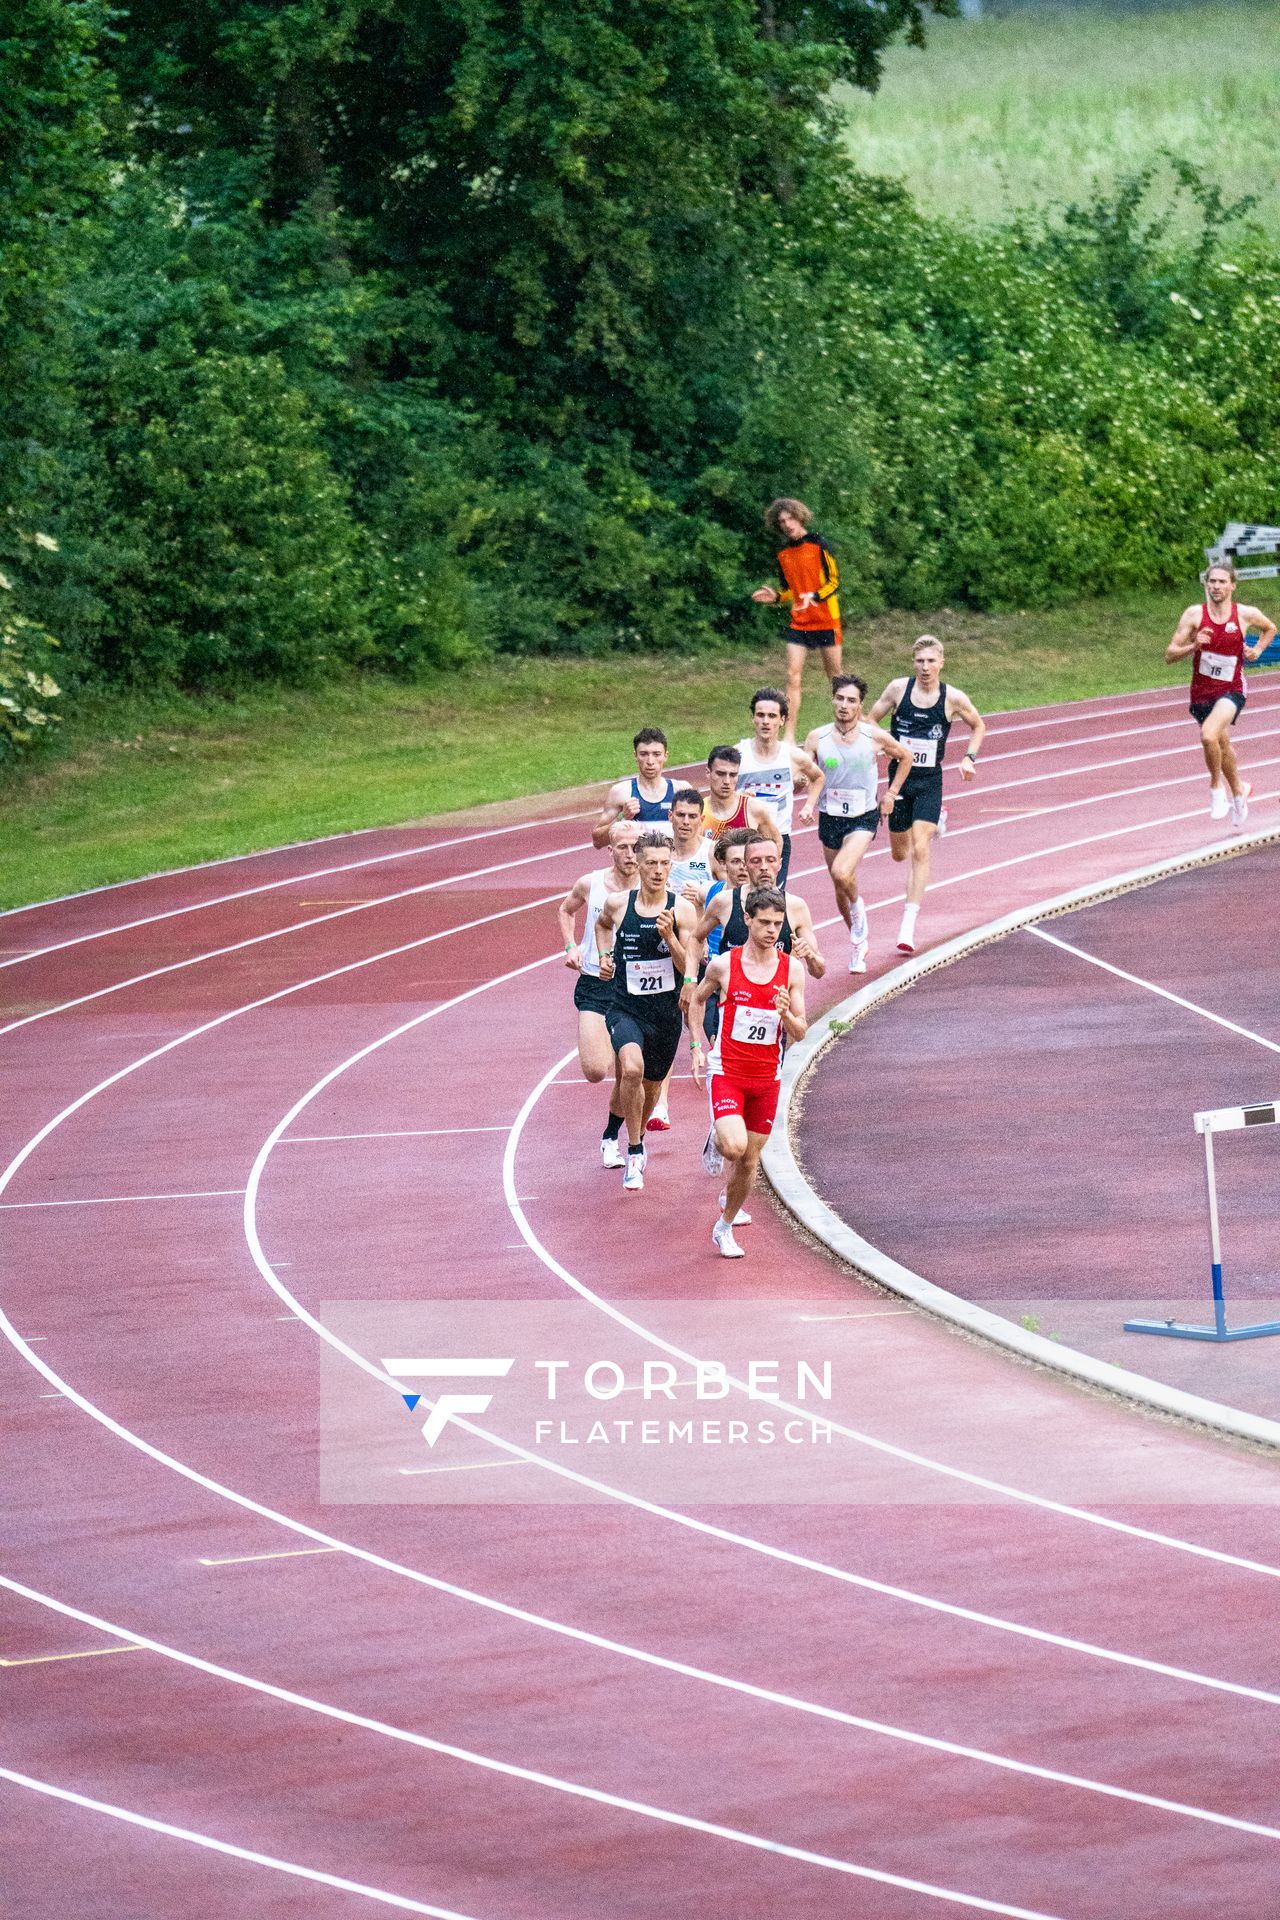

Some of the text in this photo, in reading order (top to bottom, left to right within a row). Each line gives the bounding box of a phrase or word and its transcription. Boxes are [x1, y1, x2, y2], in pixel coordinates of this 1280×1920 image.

[913, 752, 927, 764] 30
[842, 802, 849, 814] 9
[689, 861, 706, 869] SVS
[640, 976, 663, 991] 221
[739, 990, 752, 998] NORD
[747, 1025, 766, 1041] 29
[721, 1098, 738, 1107] NORD
